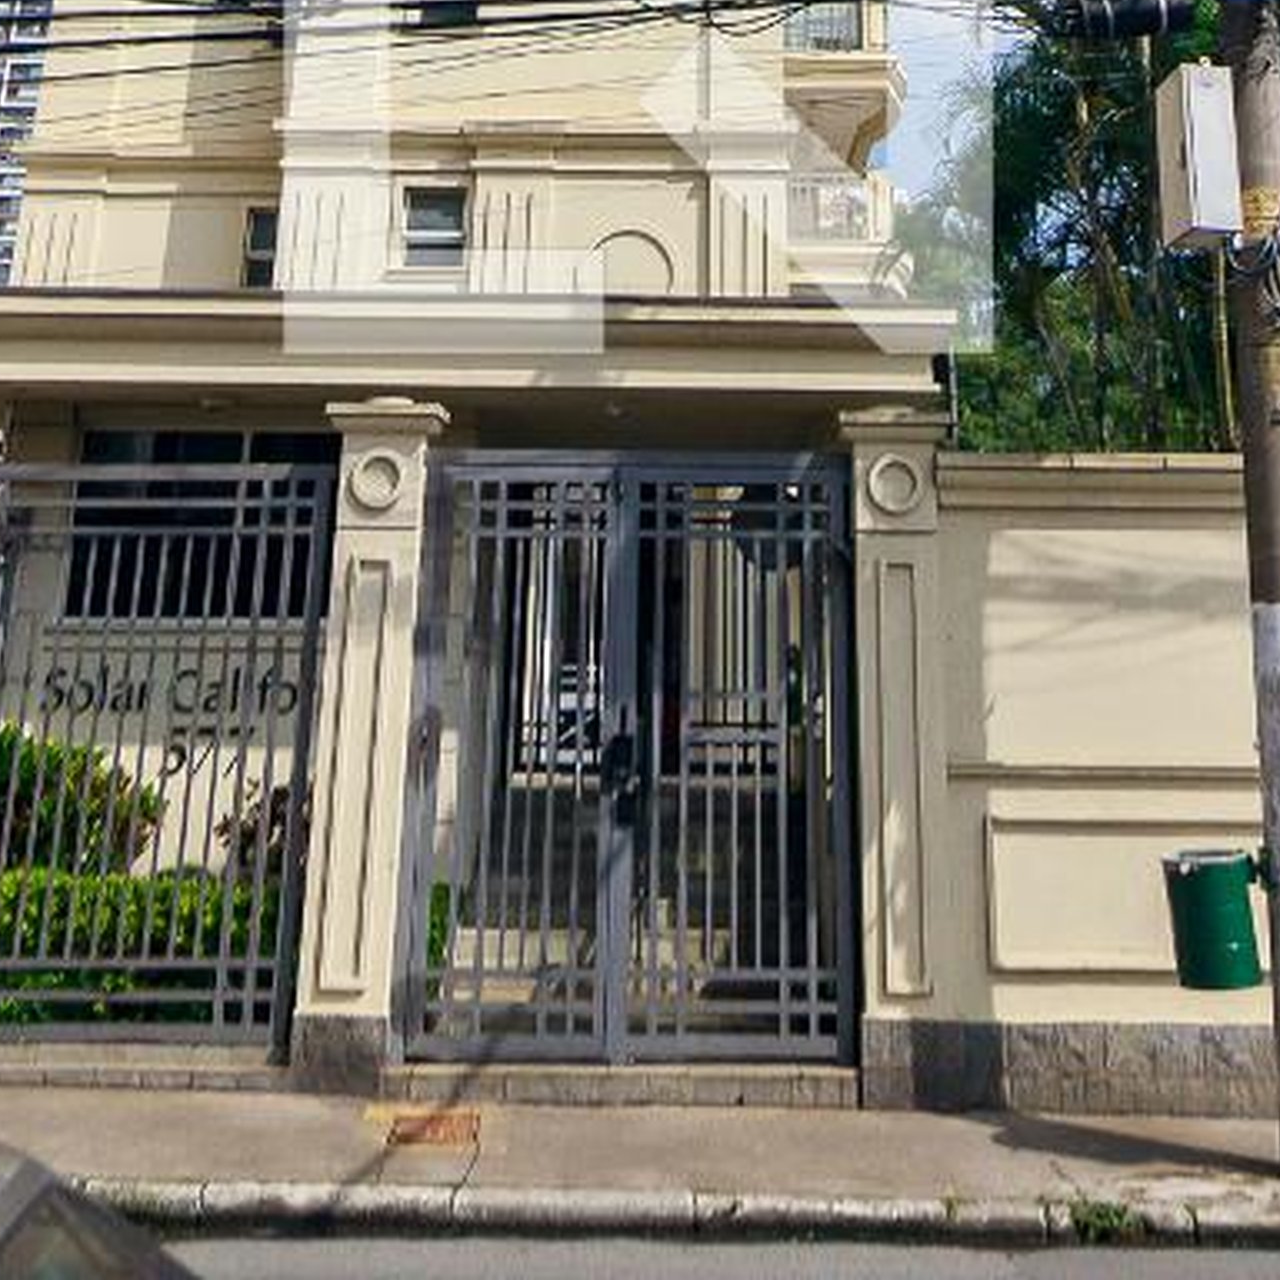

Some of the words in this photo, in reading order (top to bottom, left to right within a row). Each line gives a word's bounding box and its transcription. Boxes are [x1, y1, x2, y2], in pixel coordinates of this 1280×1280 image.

[40, 665, 148, 715] Solar
[172, 667, 299, 715] Calfo
[160, 724, 255, 778] 577
